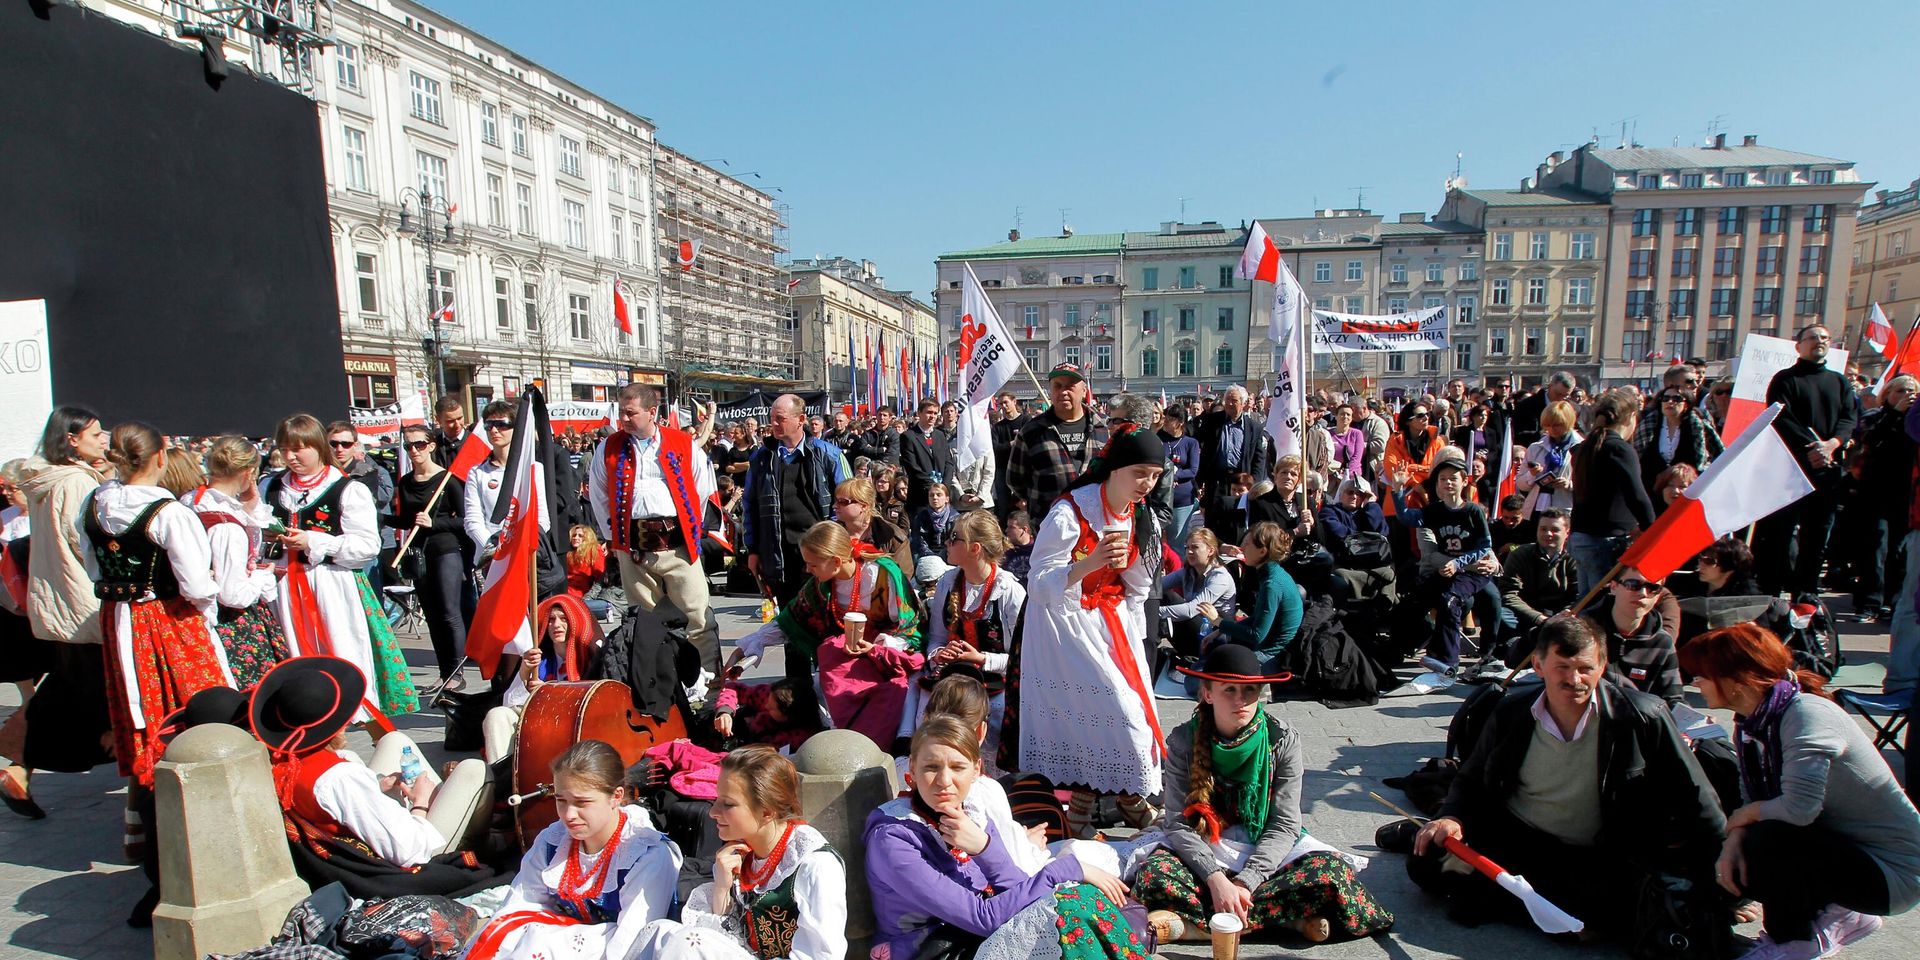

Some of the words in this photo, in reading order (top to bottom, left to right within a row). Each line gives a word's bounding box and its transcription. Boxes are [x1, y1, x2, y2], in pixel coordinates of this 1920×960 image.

[1315, 315, 1339, 331] 1940
[1421, 309, 1445, 329] 2010
[1314, 334, 1350, 345] ŁĄCZY
[1357, 333, 1380, 343] NAS
[1388, 330, 1444, 342] HISTORIA
[718, 405, 771, 420] Włoszczo
[1446, 538, 1462, 550] 13
